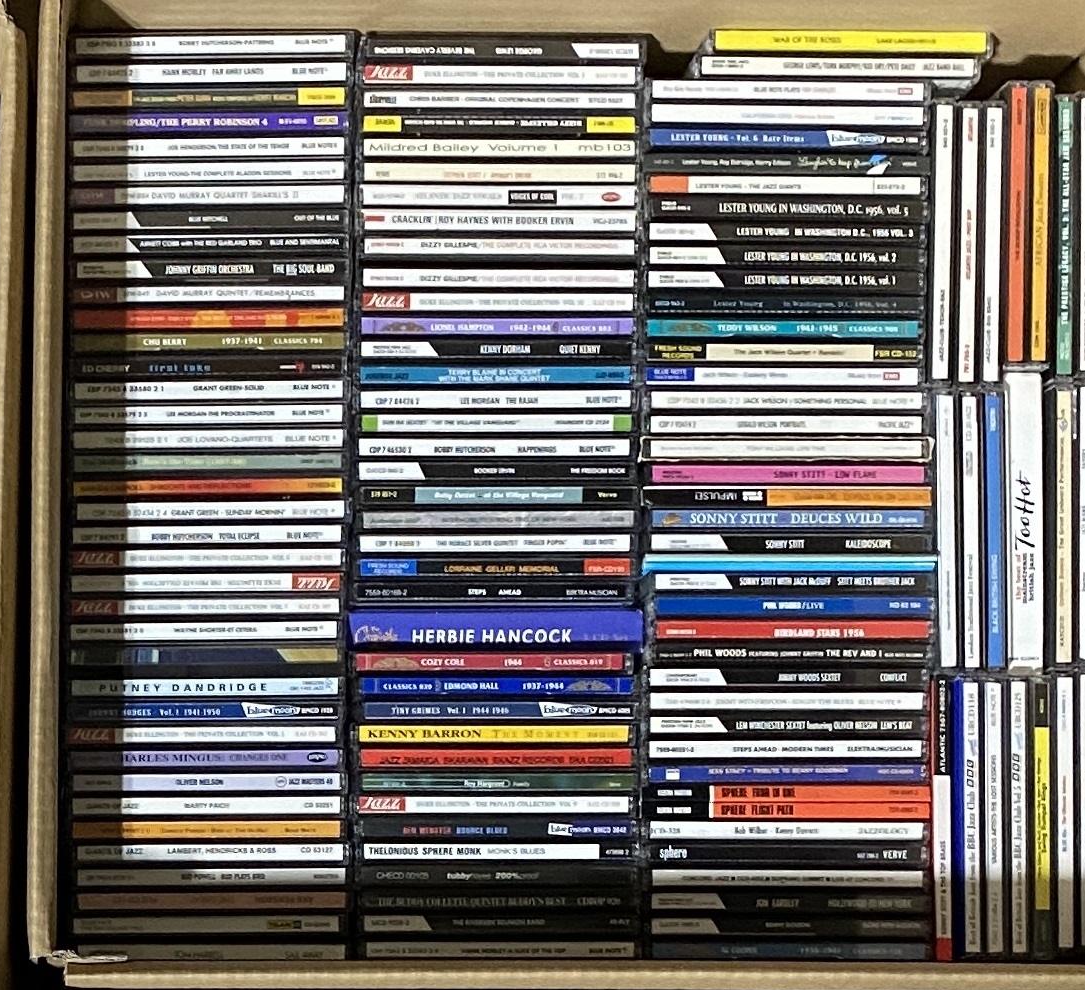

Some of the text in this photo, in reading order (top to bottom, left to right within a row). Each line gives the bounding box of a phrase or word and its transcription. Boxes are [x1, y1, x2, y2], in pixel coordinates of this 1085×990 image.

[369, 143, 547, 153] Mildred Bailey Volume
[719, 203, 777, 214] LESTER YOUNG
[457, 216, 574, 225] HAYNES WITH ERVIN
[690, 513, 882, 524] SONNY STITT DEUCES WILD
[412, 629, 572, 644] HERBIE HANCOCK
[694, 649, 712, 657] PHIL
[826, 649, 840, 657] THE
[843, 649, 857, 657] REV
[100, 683, 267, 692] PUTNEY DANDRIDGE
[480, 682, 498, 690] HALL
[368, 729, 482, 738] KENNY BARRON
[457, 847, 481, 856] MONK
